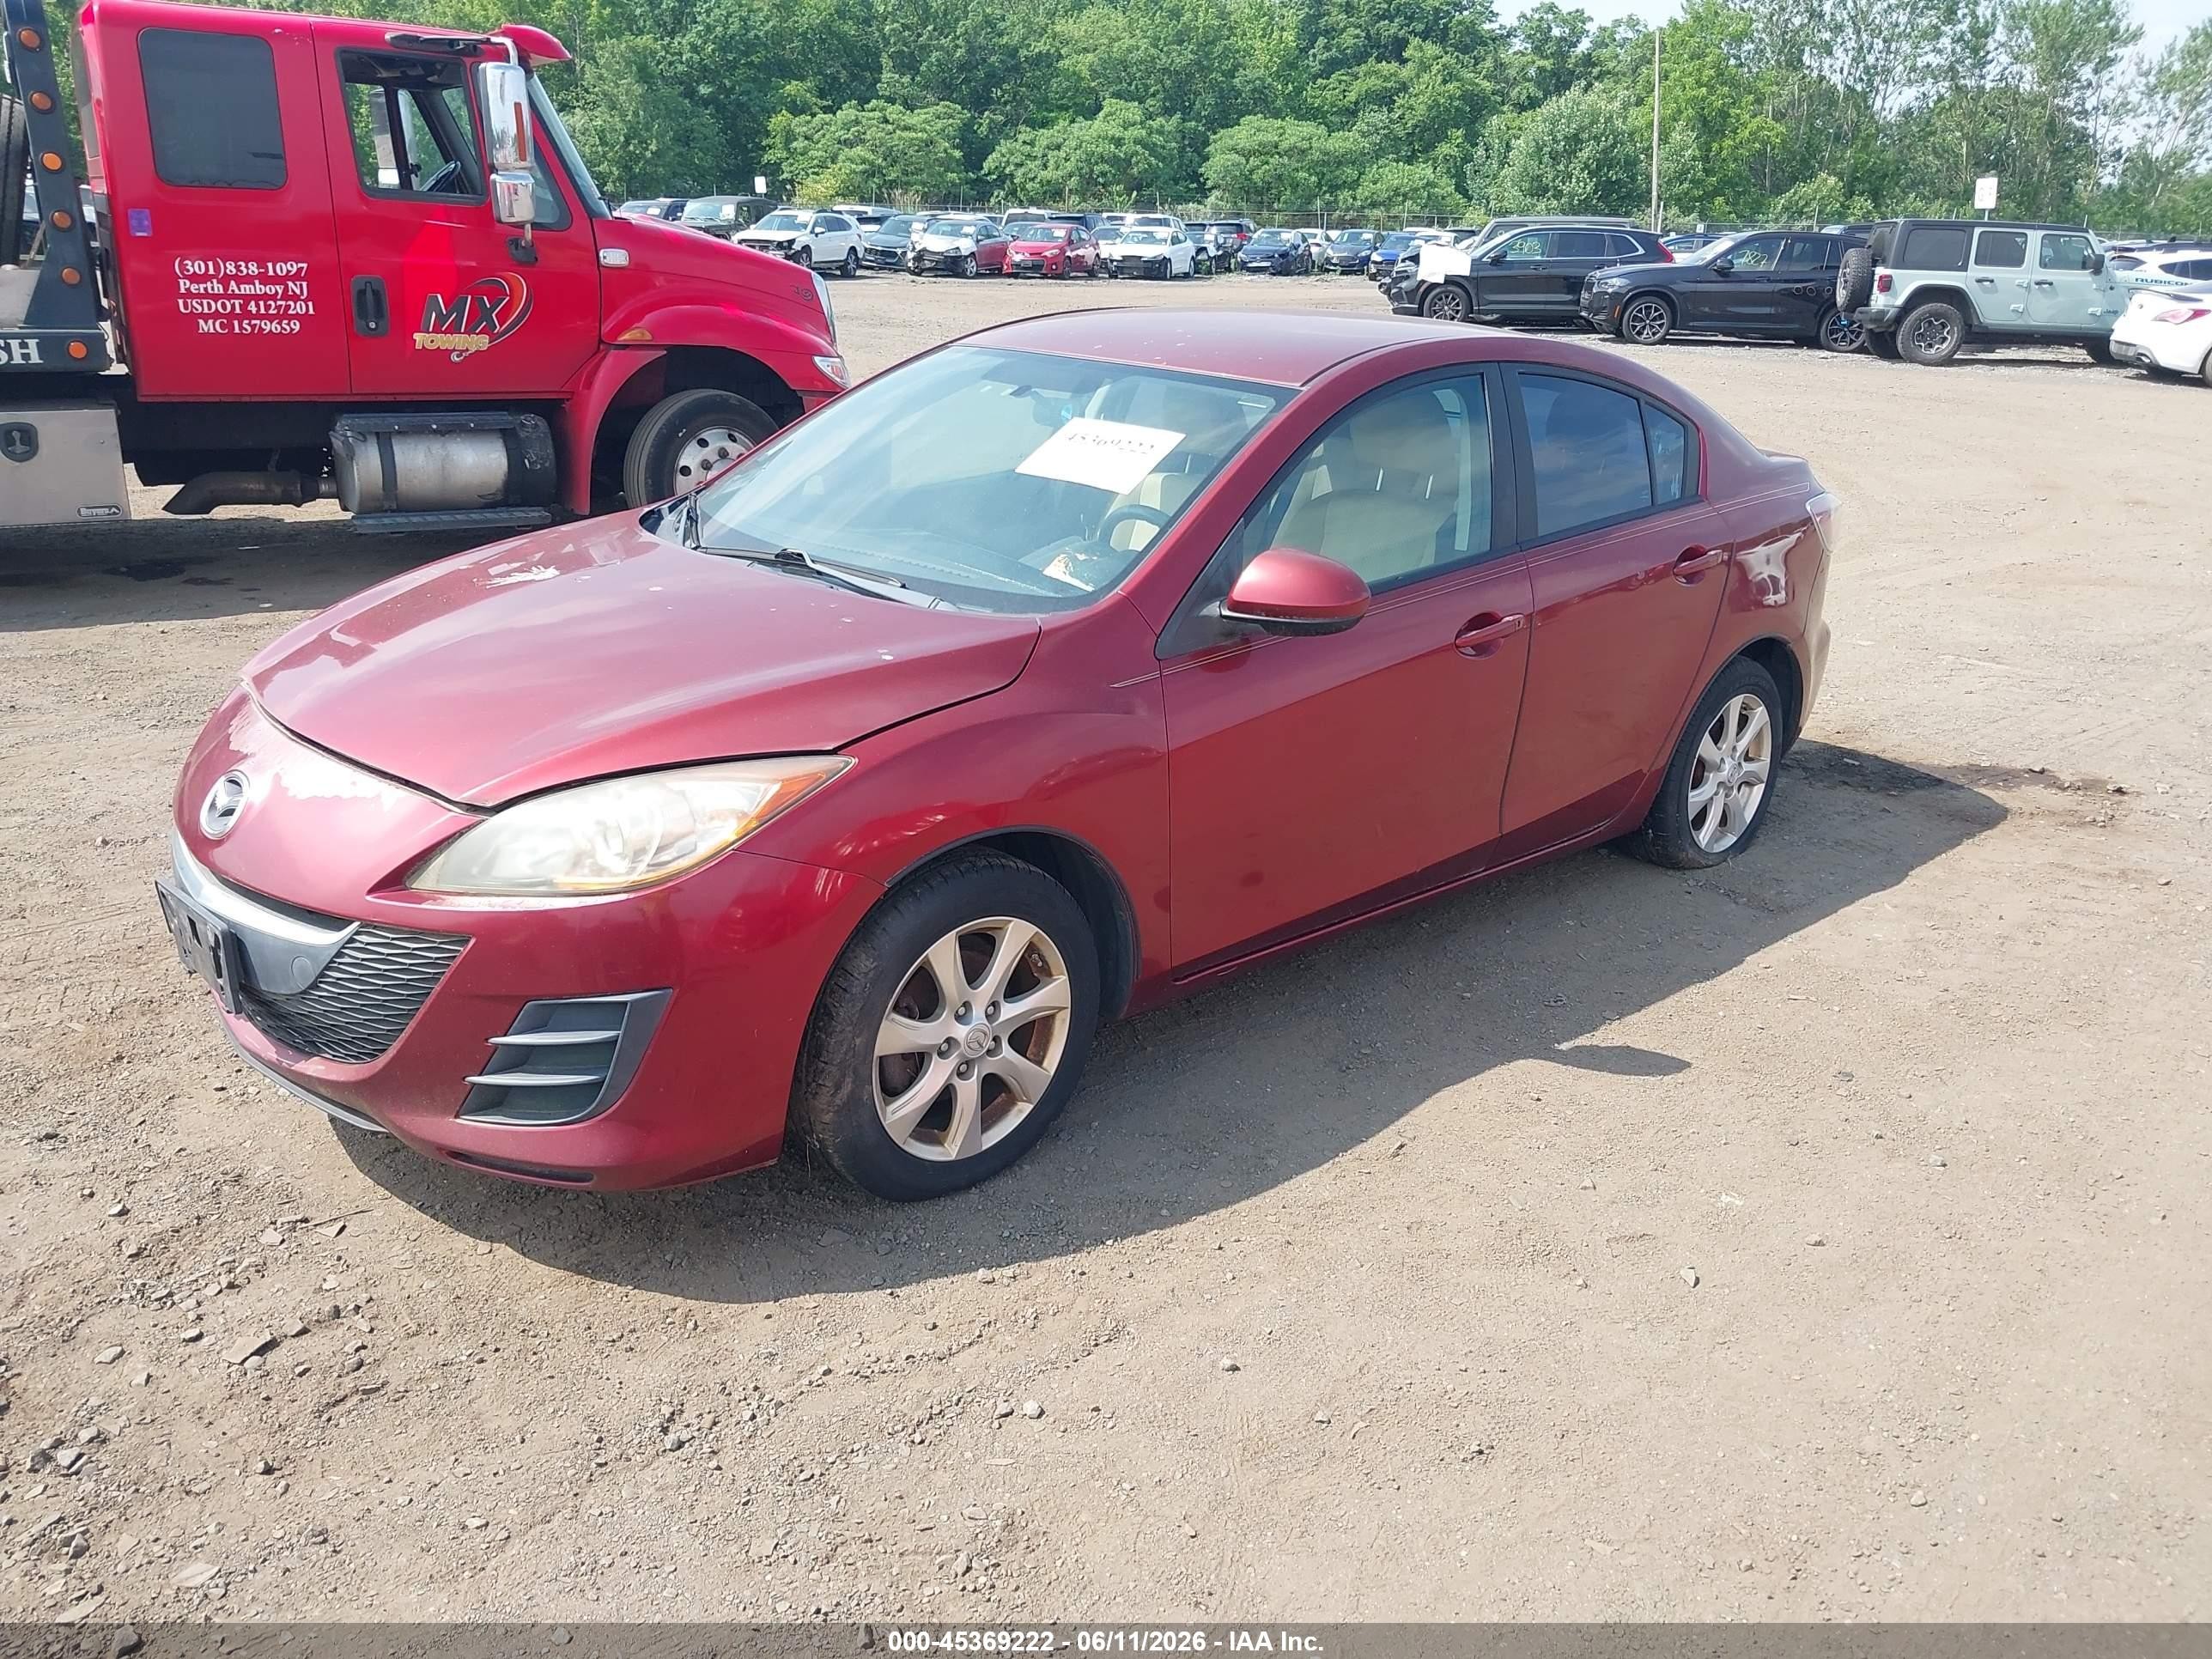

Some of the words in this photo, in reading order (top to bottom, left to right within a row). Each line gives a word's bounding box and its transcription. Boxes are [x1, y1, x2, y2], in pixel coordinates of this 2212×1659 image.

[174, 257, 308, 278] (301)838-1097
[178, 278, 224, 295] Perth
[227, 279, 284, 300] Amboy
[286, 281, 308, 300] NJ
[177, 299, 244, 314] USDOT
[246, 300, 316, 315] 4127201
[420, 293, 510, 334] MX
[198, 319, 229, 334] MC
[233, 319, 301, 335] 1579659
[413, 332, 490, 351] TOWING
